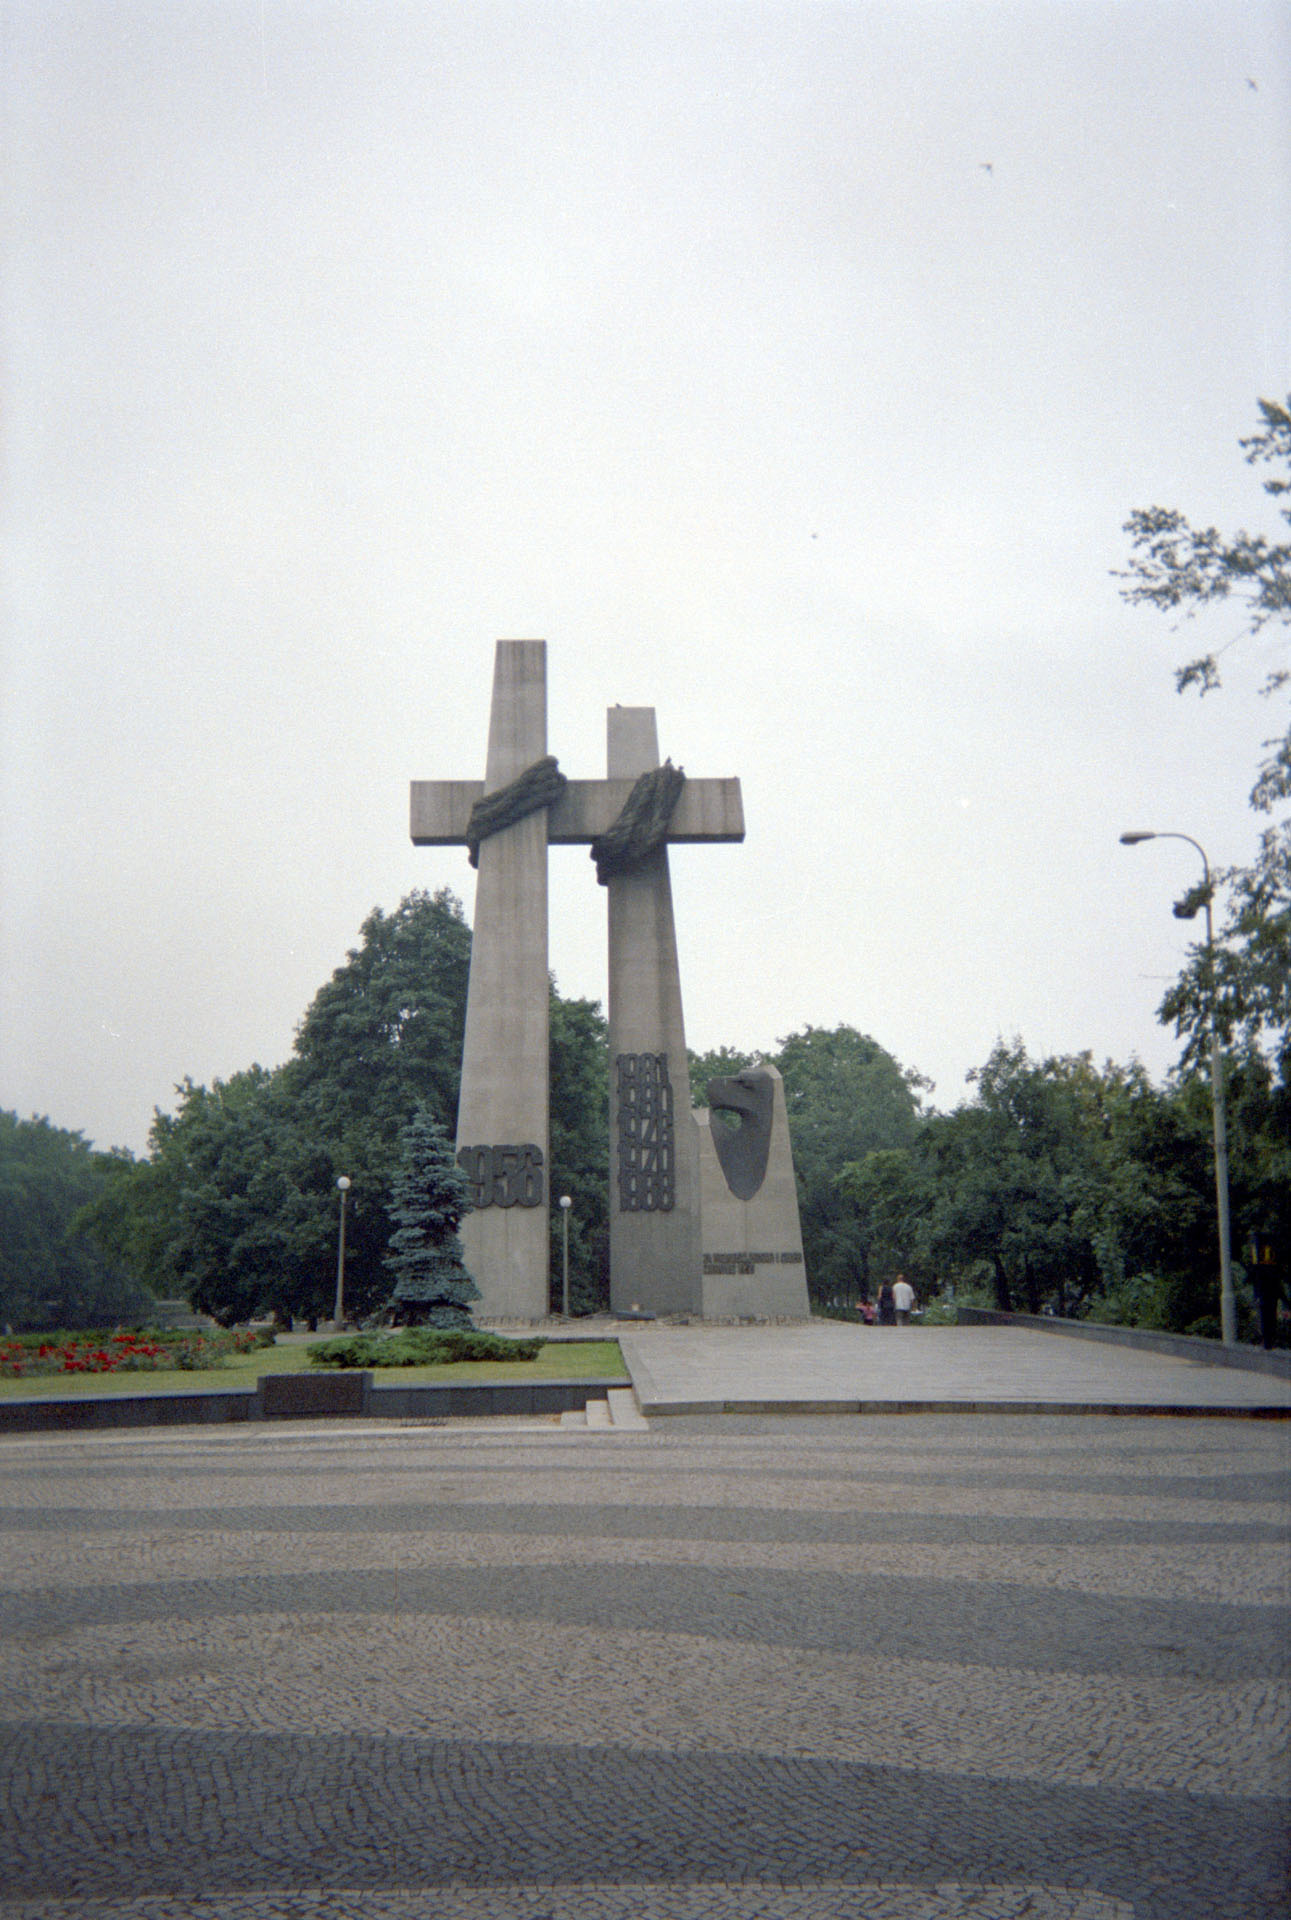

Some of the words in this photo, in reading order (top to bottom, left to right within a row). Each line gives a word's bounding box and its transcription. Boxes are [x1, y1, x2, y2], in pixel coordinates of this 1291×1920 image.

[616, 1053, 668, 1083] 1981
[617, 1083, 673, 1113] 1980
[617, 1113, 674, 1142] 1976
[617, 1142, 674, 1171] 1970
[617, 1171, 674, 1212] 1968
